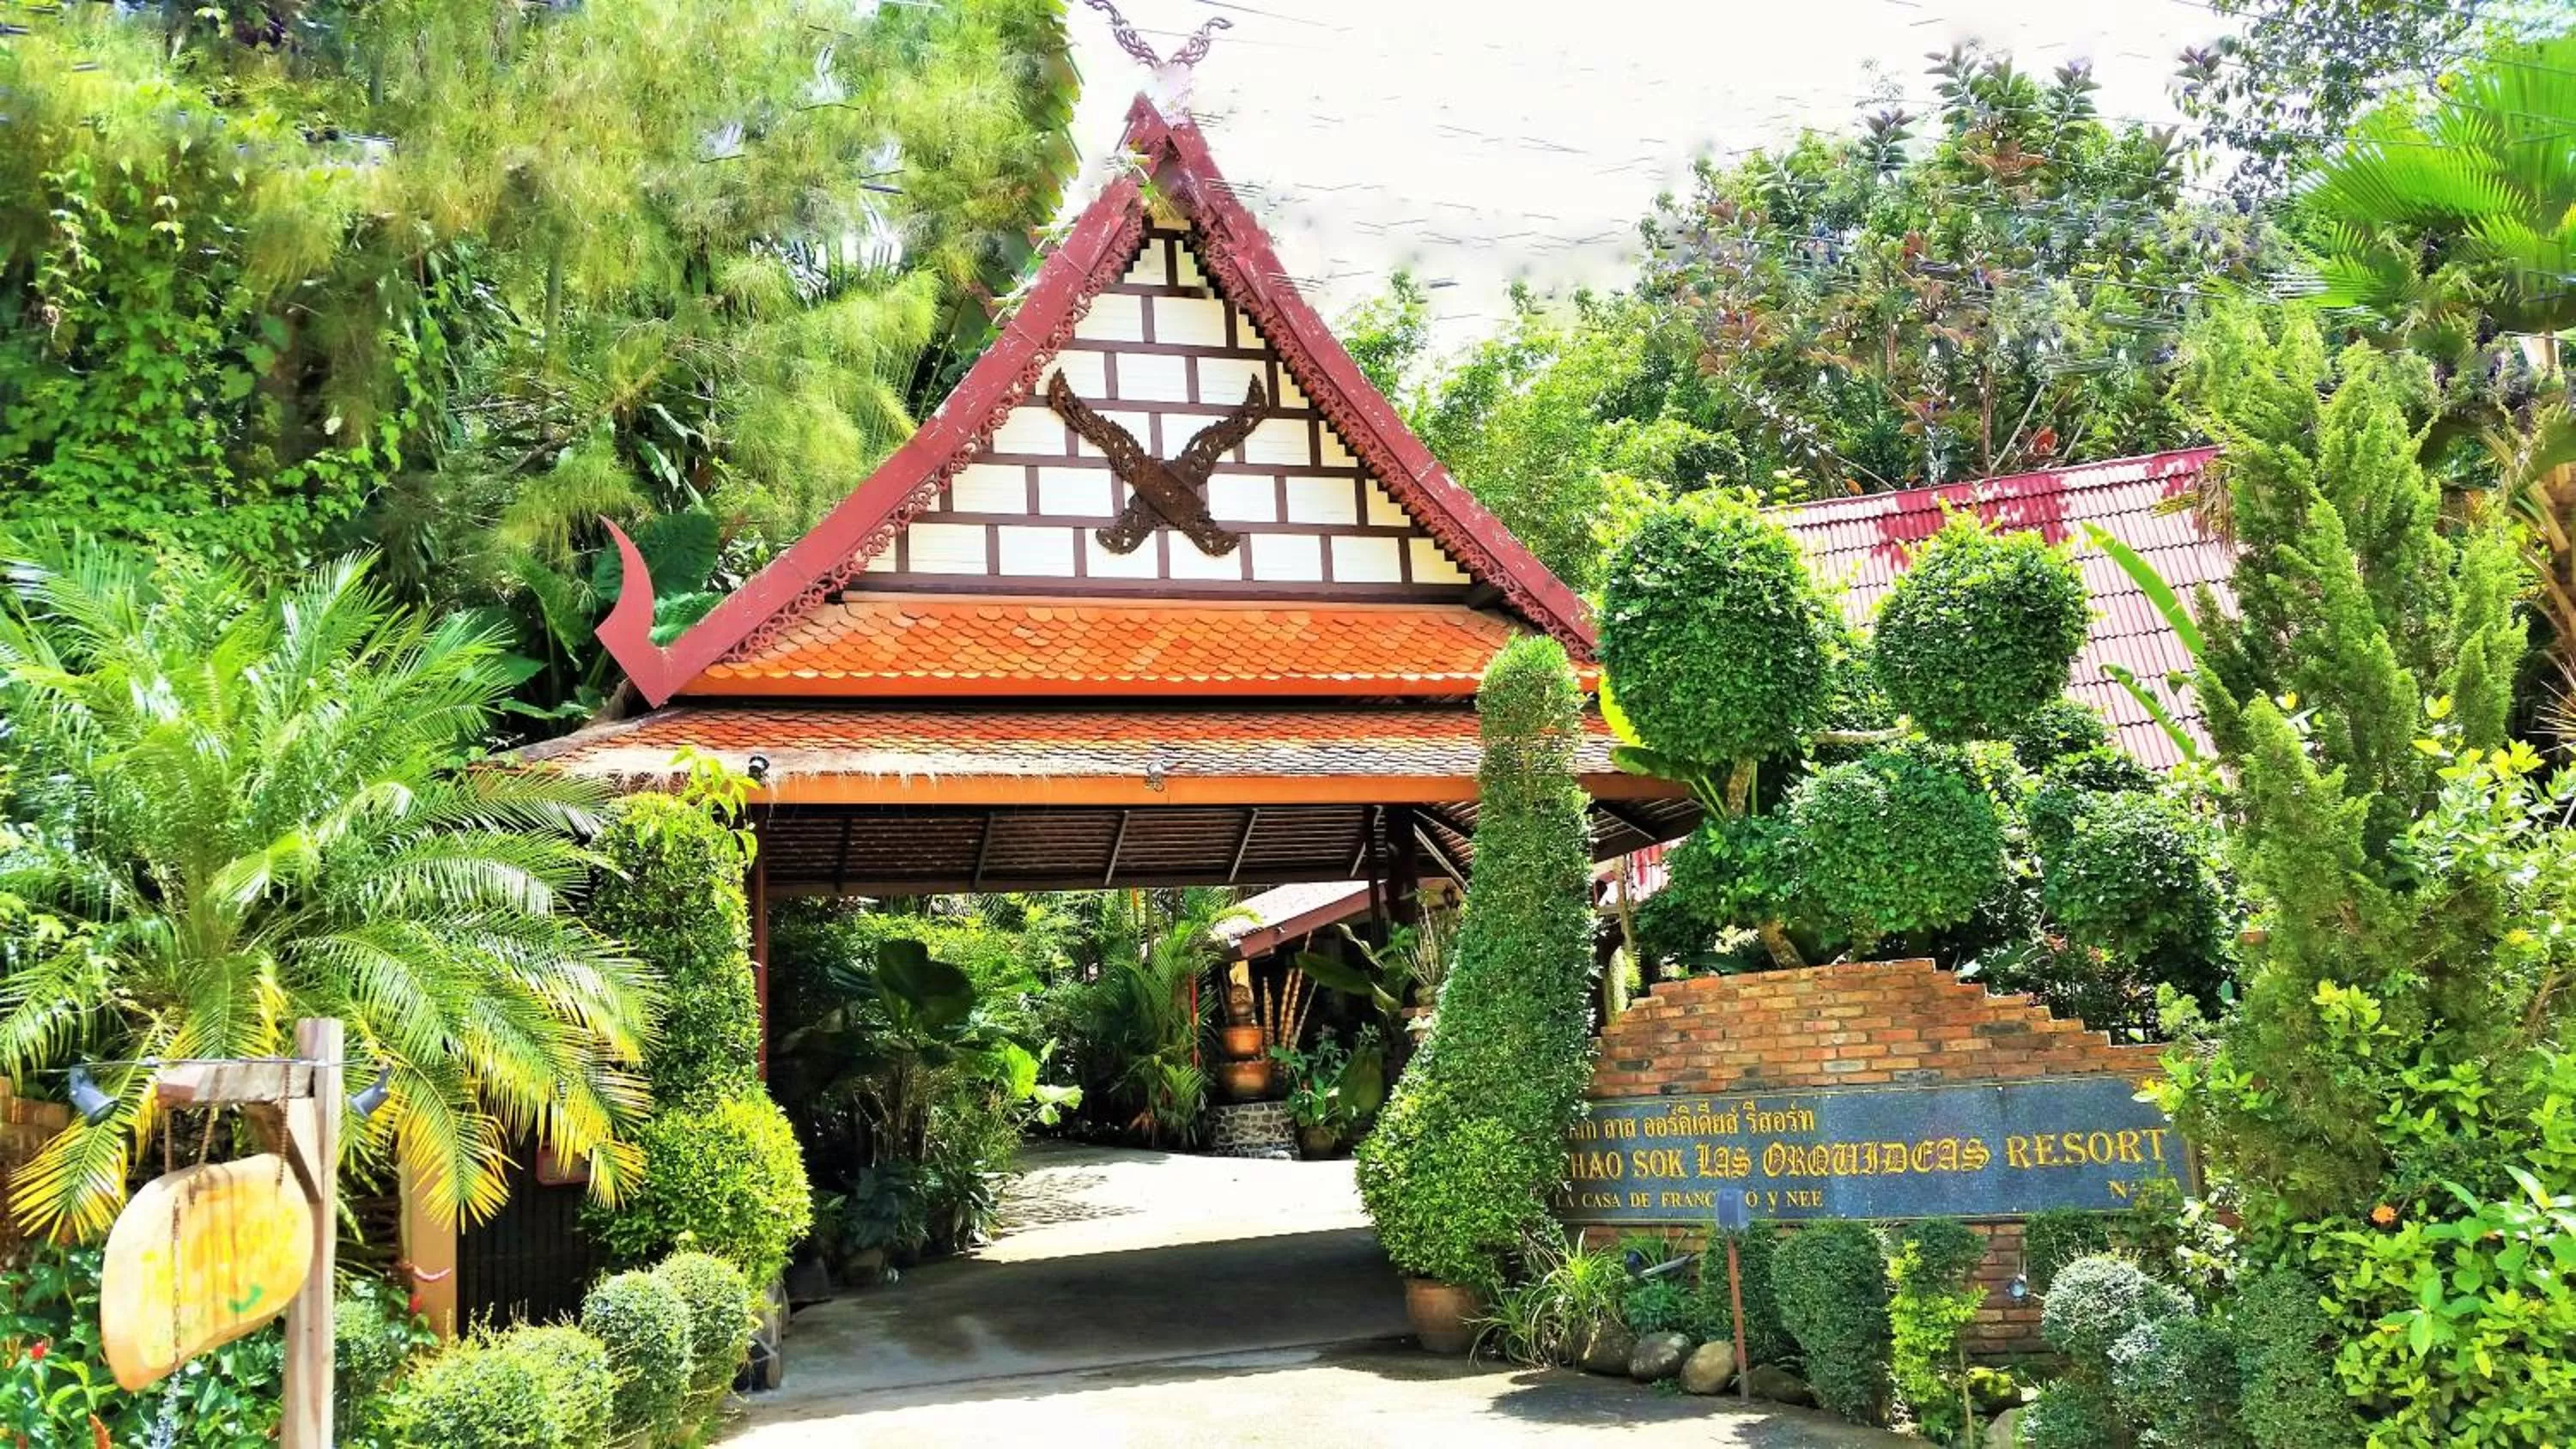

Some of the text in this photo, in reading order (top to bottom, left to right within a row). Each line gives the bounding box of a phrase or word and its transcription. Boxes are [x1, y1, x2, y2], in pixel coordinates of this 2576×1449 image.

[1564, 1150, 1623, 1180] HAO
[1632, 1146, 1689, 1179] SOK
[1763, 1137, 1992, 1177] ORQUIDEAS
[2005, 1128, 2169, 1169] RESORT
[1582, 1191, 1622, 1209] CASA
[1631, 1191, 1651, 1209] DE
[1661, 1190, 1759, 1209] FRANCO
[1785, 1190, 1824, 1208] NEE
